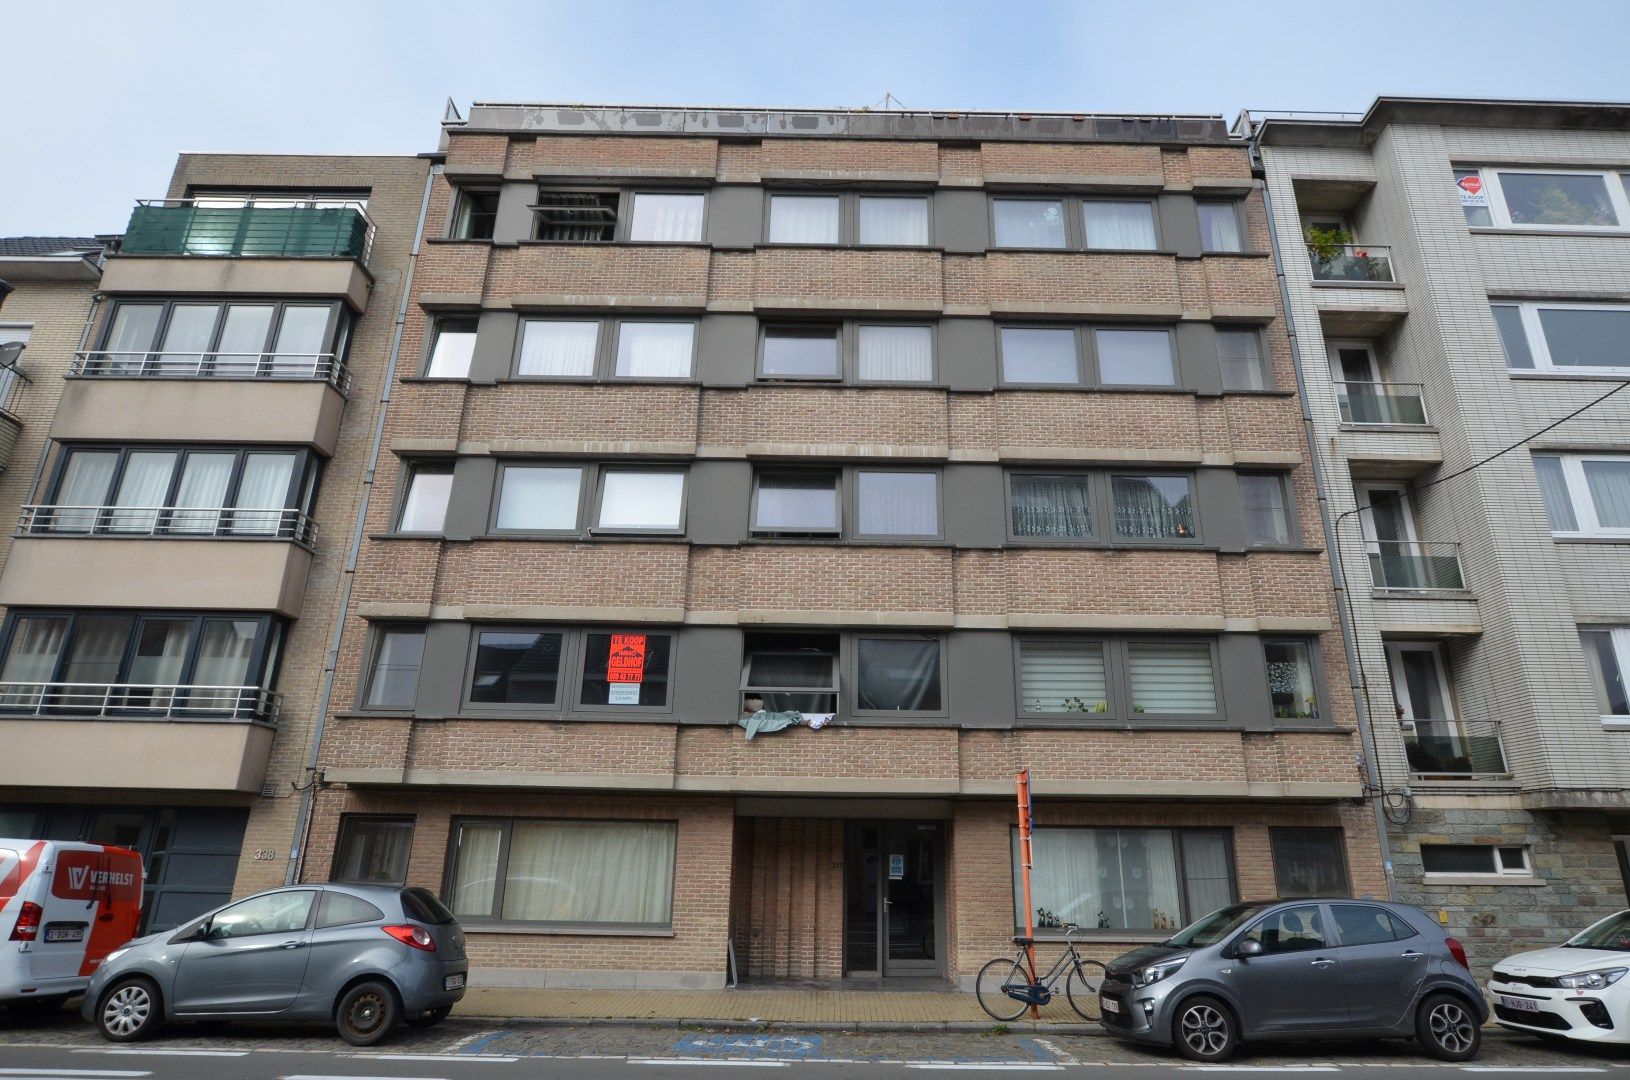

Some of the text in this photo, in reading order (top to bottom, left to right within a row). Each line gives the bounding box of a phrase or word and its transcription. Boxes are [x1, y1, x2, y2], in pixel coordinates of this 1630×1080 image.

[613, 636, 644, 645] TE KOOP
[611, 656, 643, 668] GELDHOF
[255, 849, 275, 860] 338
[90, 870, 134, 886] VERHELST
